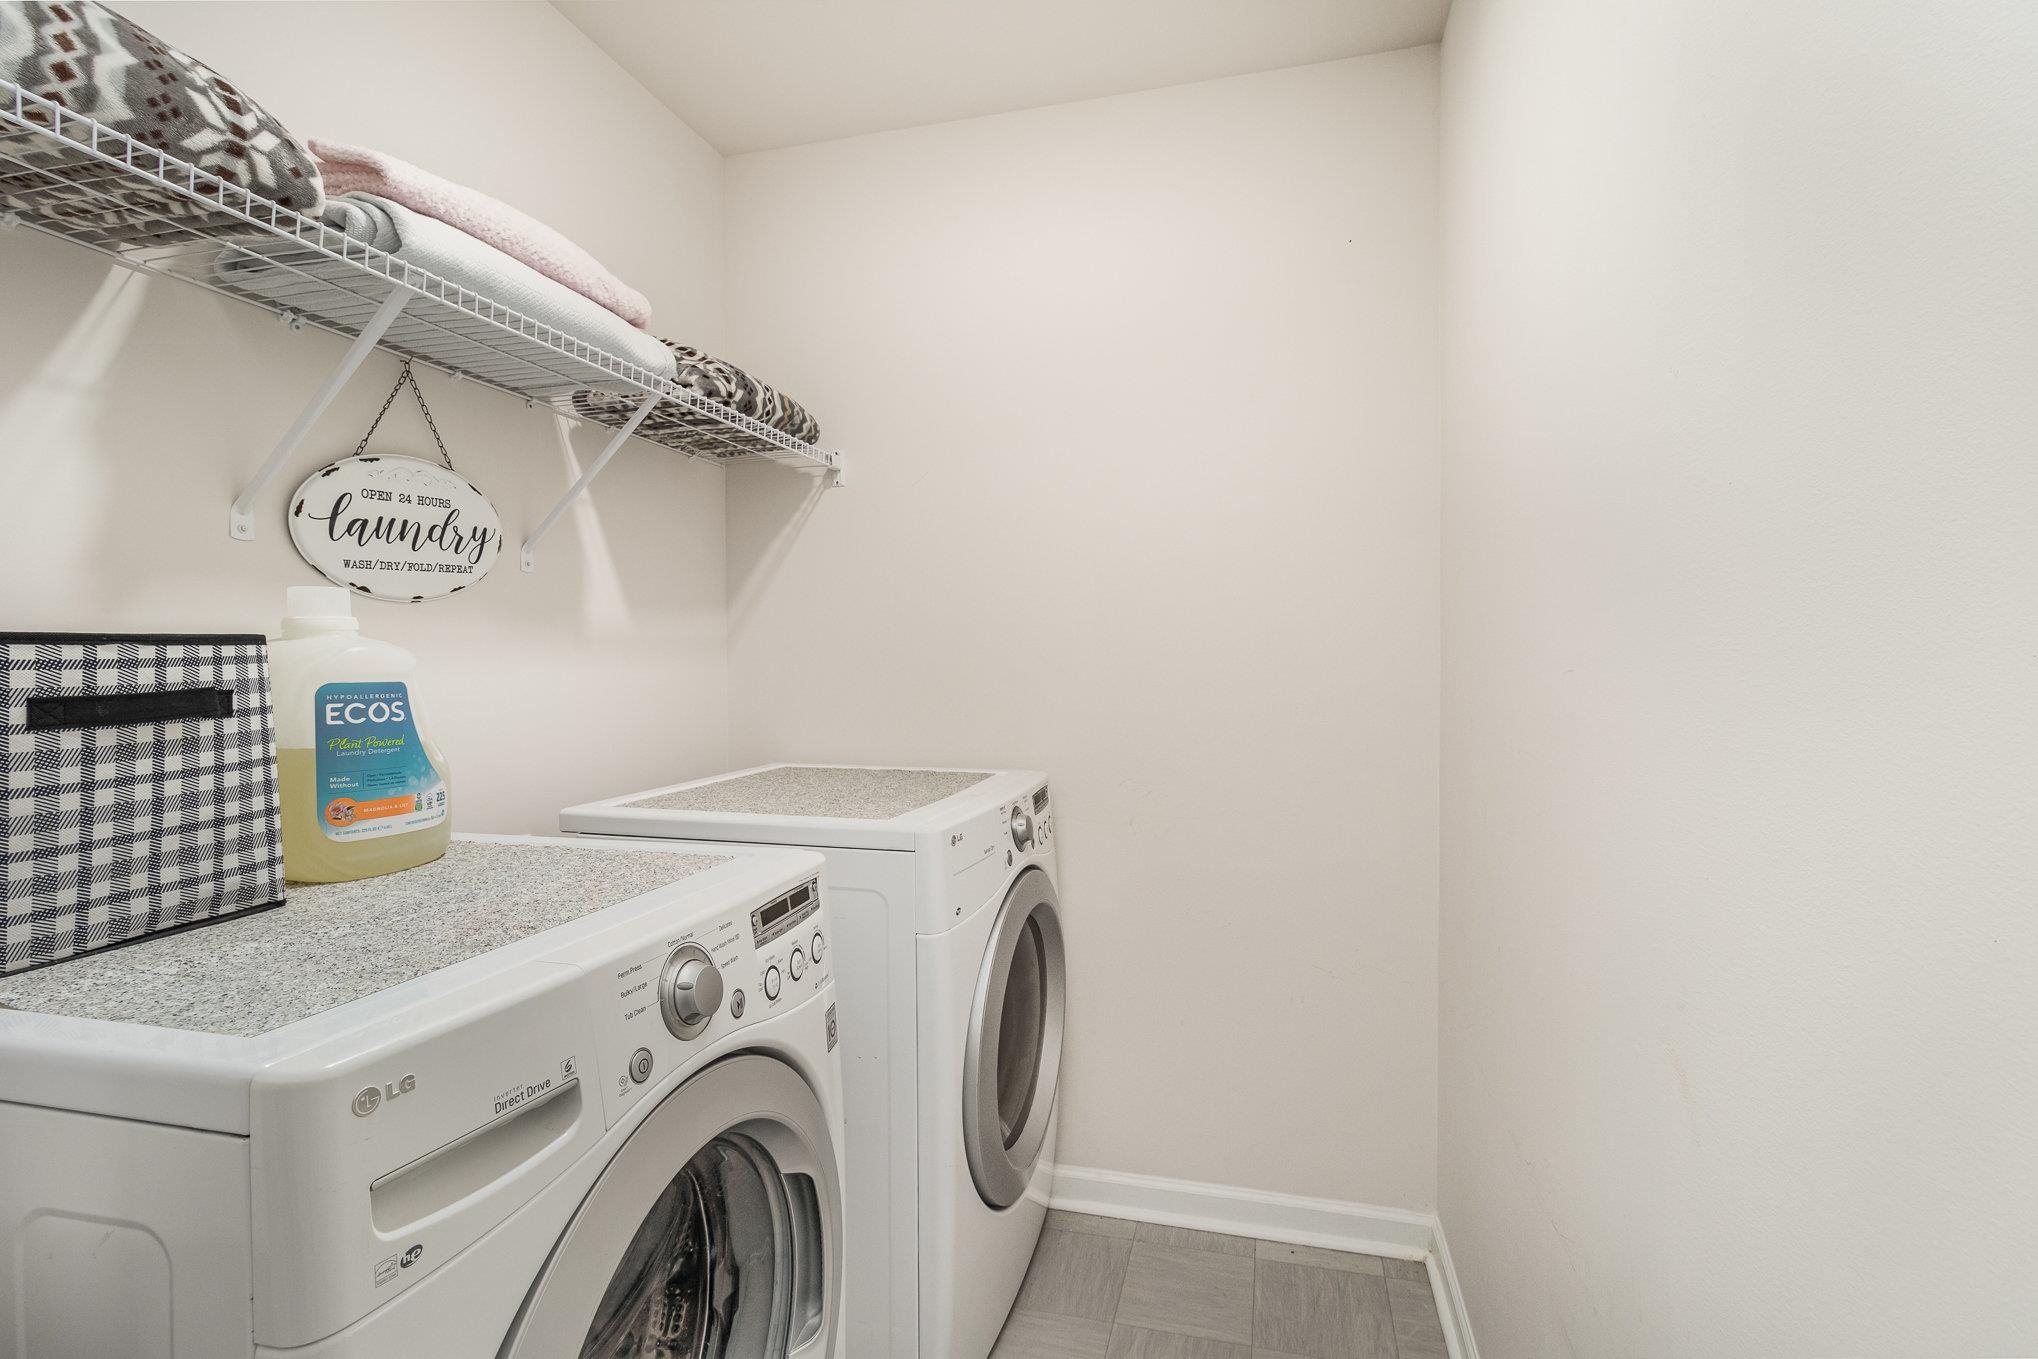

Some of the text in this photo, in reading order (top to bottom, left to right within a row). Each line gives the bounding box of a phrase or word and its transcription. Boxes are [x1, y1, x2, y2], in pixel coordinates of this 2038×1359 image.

[361, 488, 451, 509] OPEN 24 HOURS
[308, 492, 496, 564] laundry
[343, 559, 474, 574] WASH/DRY/FOLD/REPEAT
[325, 701, 405, 725] ECOS
[327, 734, 405, 751] Plant Powered
[336, 747, 401, 757] Laundry Detergent
[436, 790, 445, 802] 225
[617, 964, 643, 980] Perm Press
[620, 981, 648, 999] Bulky/Large
[624, 1006, 647, 1021] Tub Clean
[385, 1073, 416, 1101] LG
[493, 1083, 524, 1102] Inverter
[494, 1078, 551, 1115] Direct Drive
